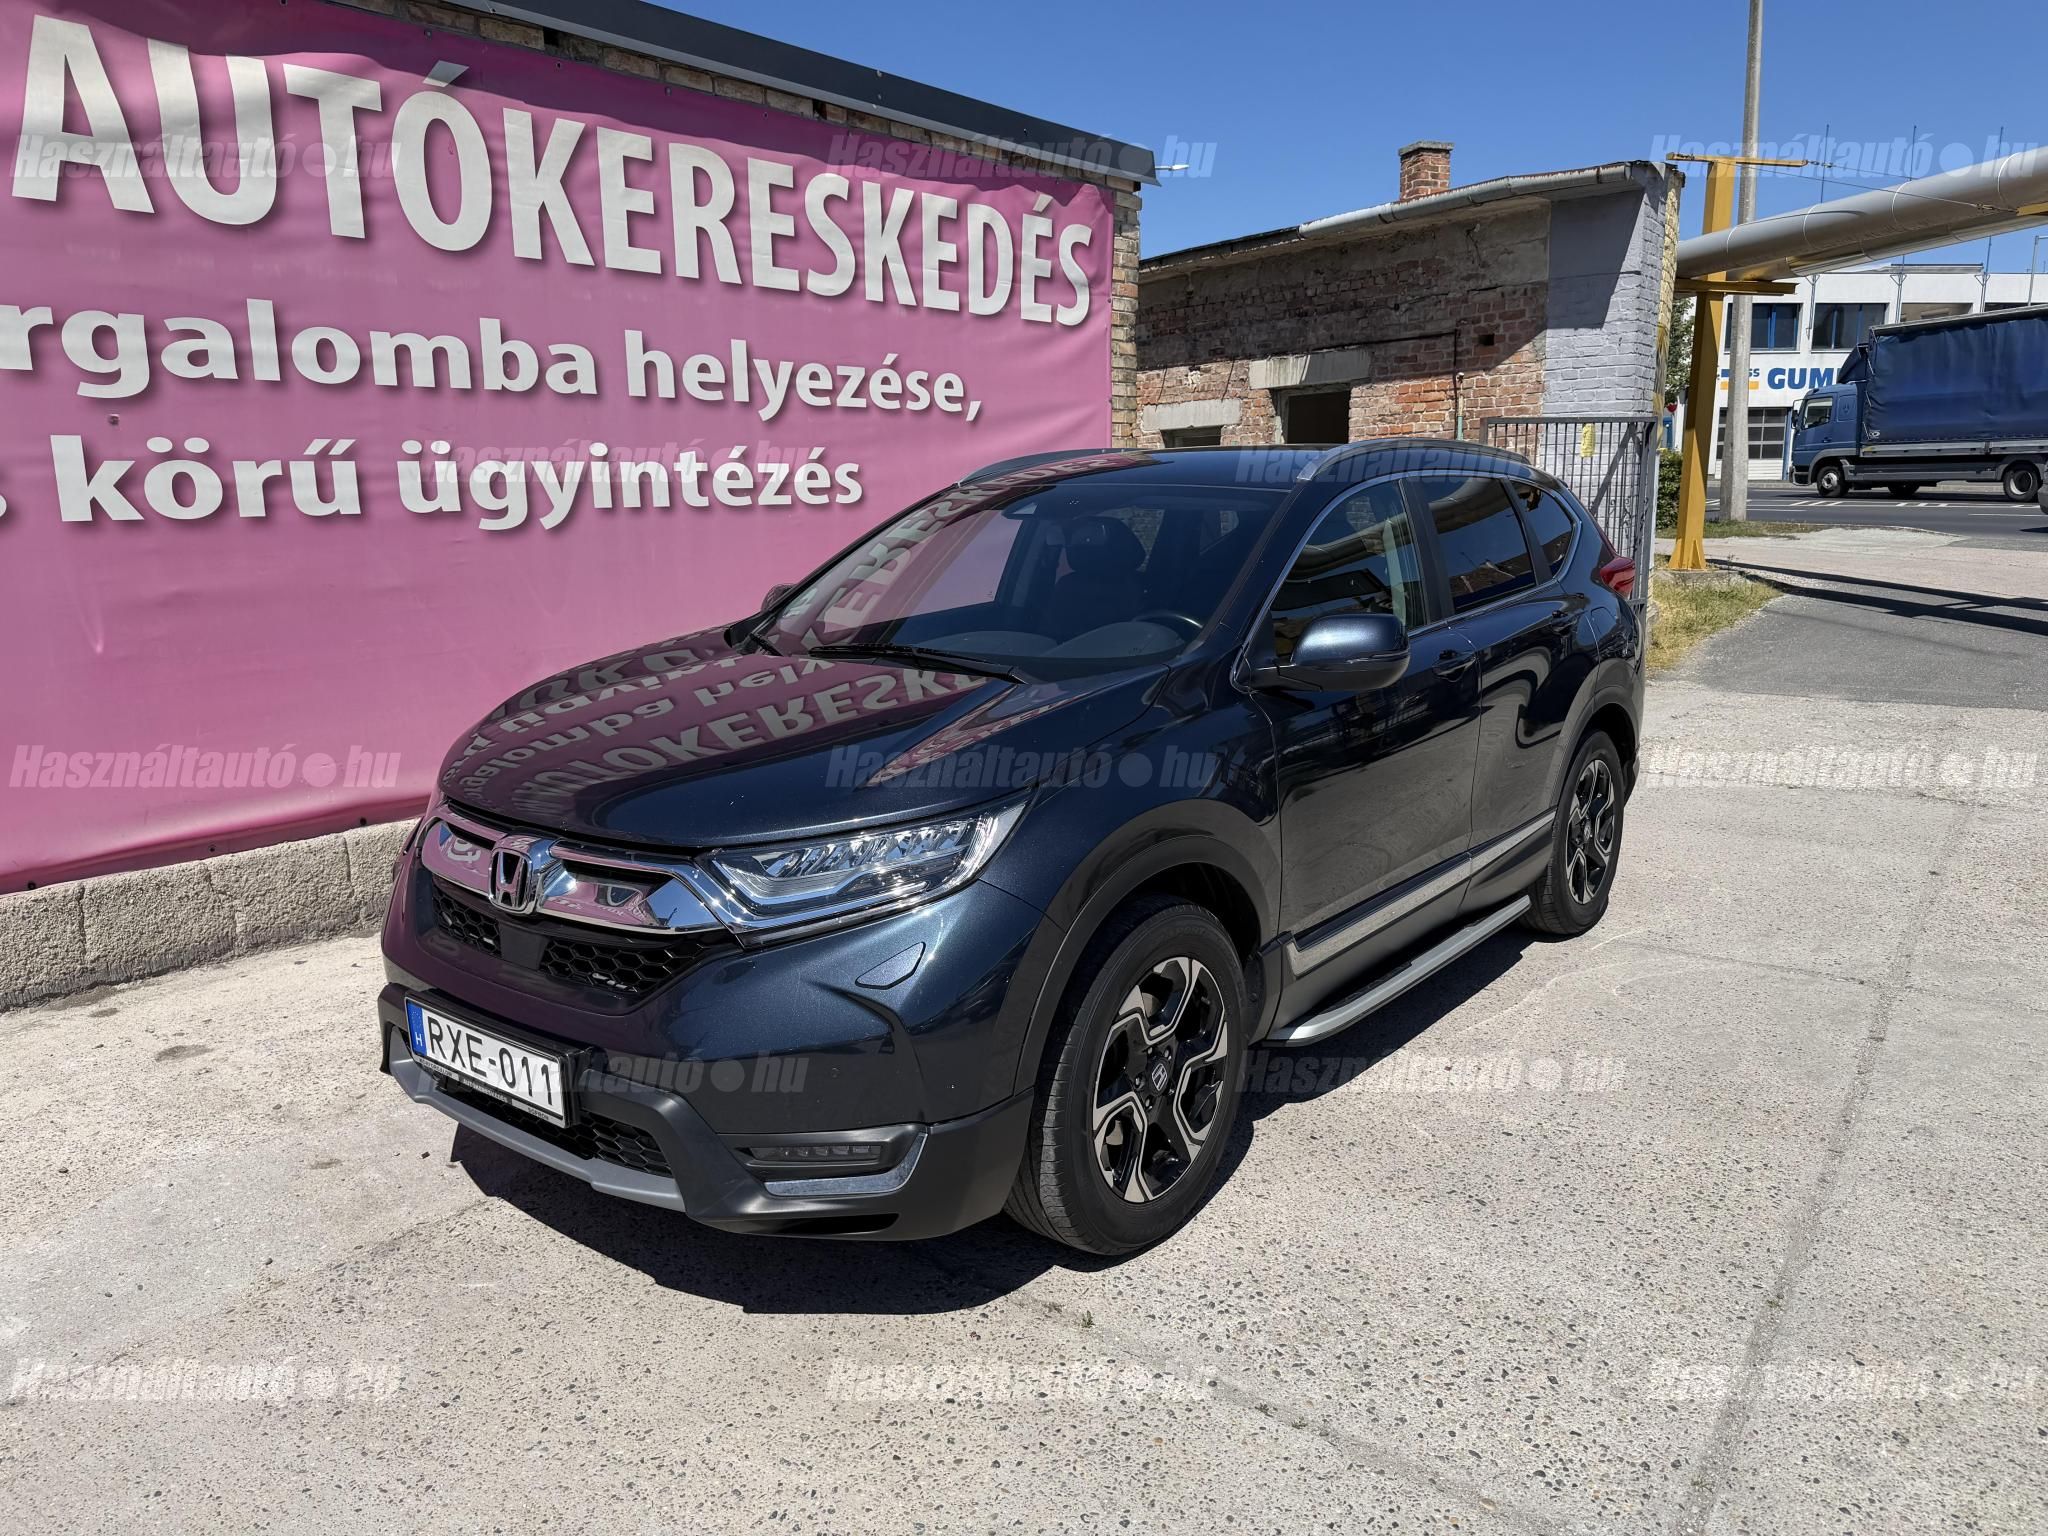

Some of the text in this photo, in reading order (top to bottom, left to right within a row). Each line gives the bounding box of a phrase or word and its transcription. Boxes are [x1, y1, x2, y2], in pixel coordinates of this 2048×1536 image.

[12, 14, 1092, 327] AUTÓKERESKEDÉS
[624, 329, 983, 423] helyezése,
[50, 434, 865, 531] körű ügyintézés
[415, 1033, 423, 1046] H
[427, 1015, 553, 1106] RXE-011
